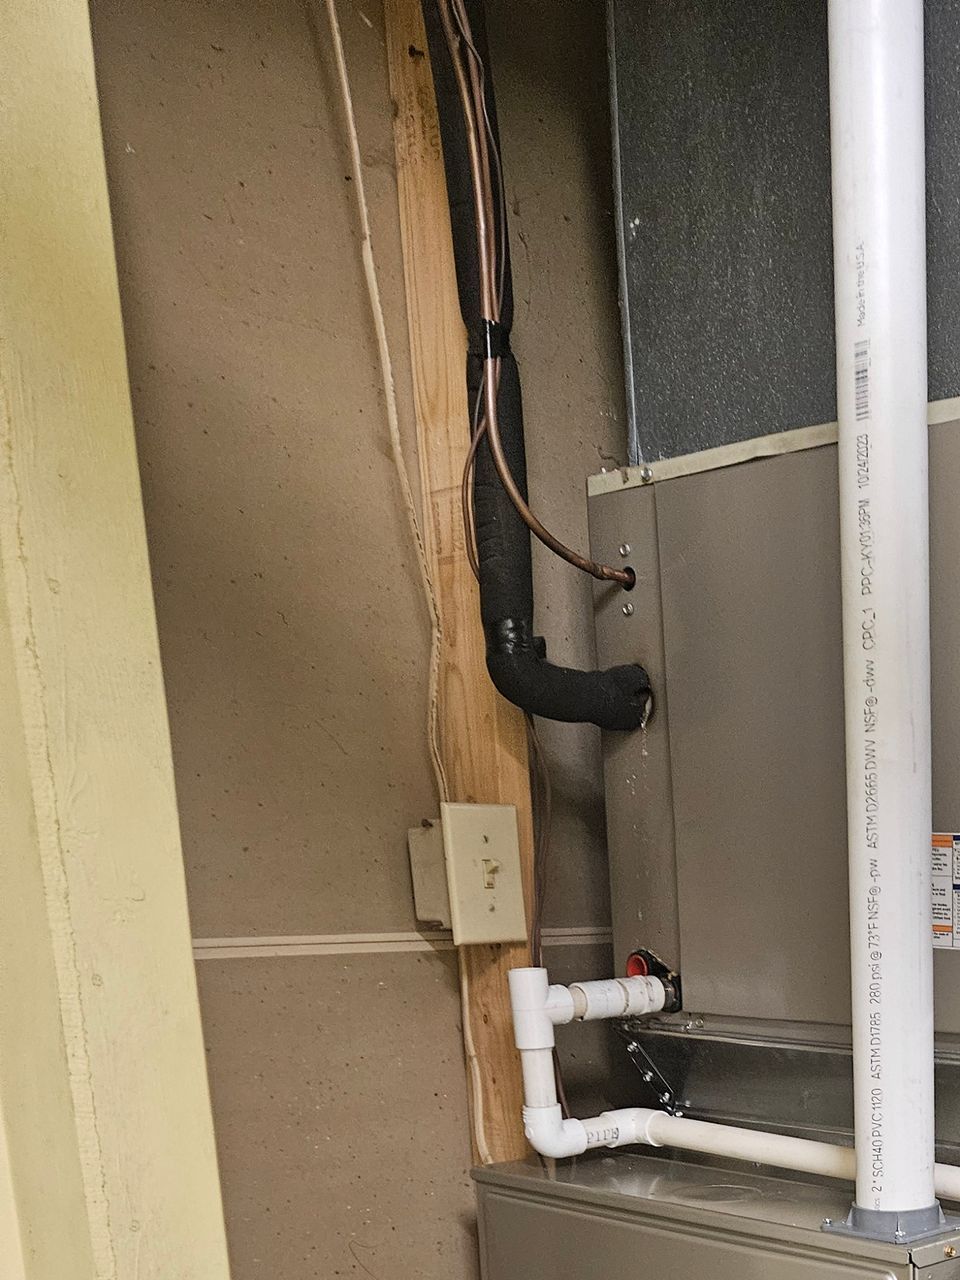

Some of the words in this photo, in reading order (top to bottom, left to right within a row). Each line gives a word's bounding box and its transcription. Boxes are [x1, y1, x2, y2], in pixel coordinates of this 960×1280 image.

[864, 739, 877, 769] DWV
[864, 772, 878, 812] D2665
[865, 815, 878, 848] ASTM
[867, 963, 882, 980] psi
[869, 983, 881, 1004] 280
[869, 1048, 881, 1080] ASTM
[870, 1088, 882, 1111] 1120
[871, 1113, 883, 1138] PVC
[871, 1140, 883, 1177] SCH40
